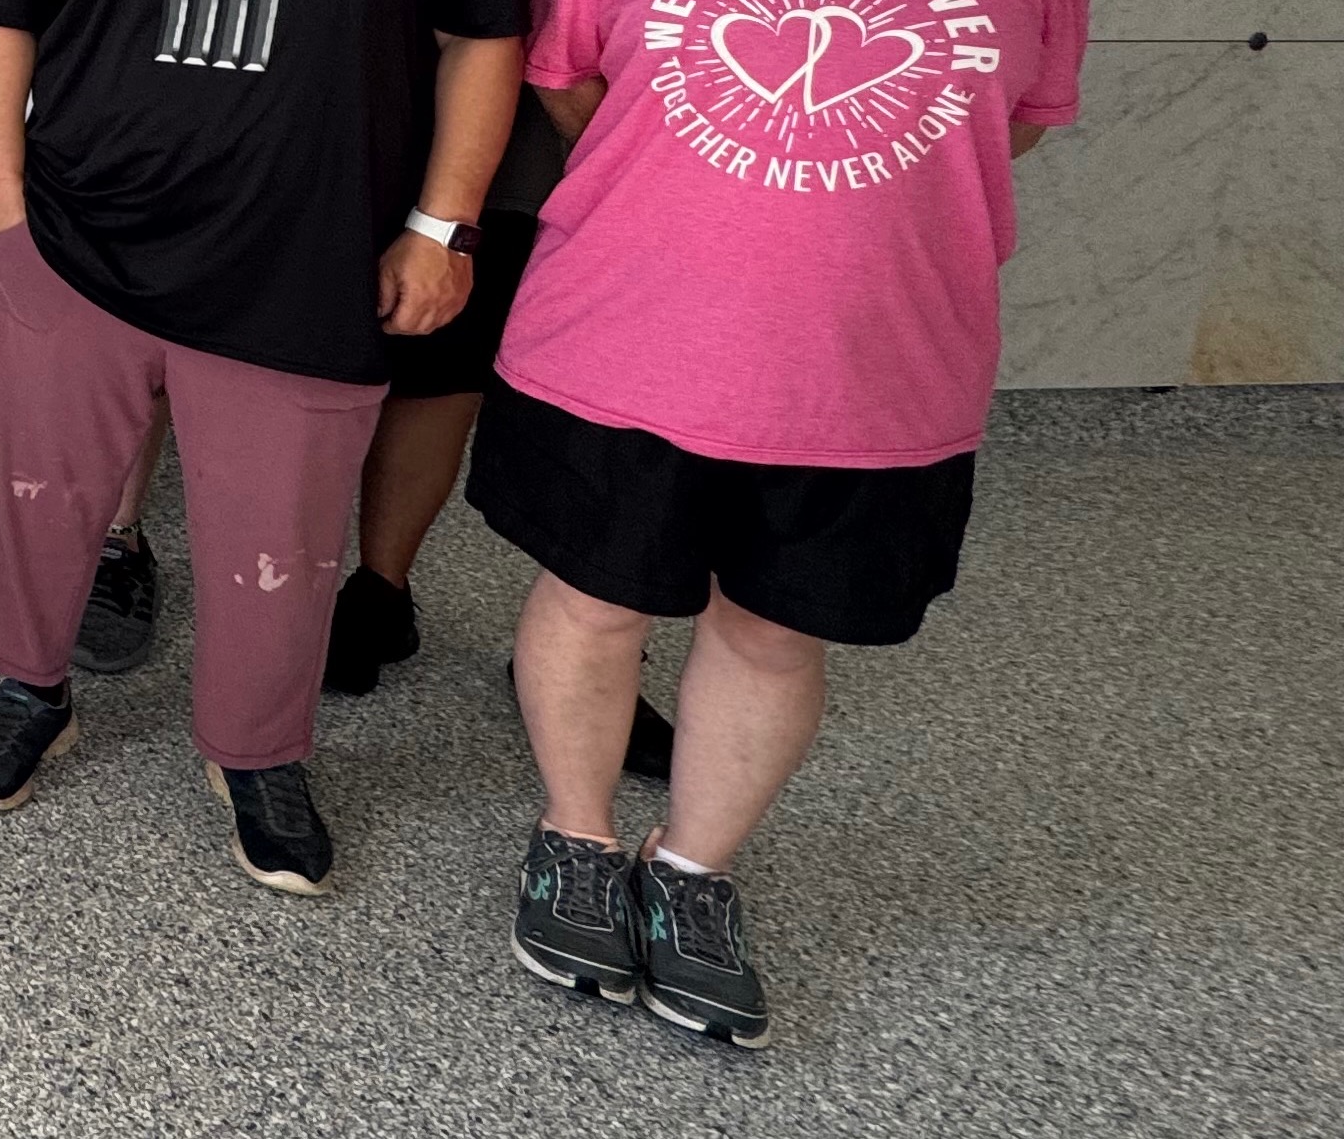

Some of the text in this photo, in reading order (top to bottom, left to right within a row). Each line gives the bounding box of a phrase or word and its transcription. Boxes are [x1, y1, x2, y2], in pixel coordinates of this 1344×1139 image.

[650, 55, 976, 193] TOGETHER NEVER ALONE
